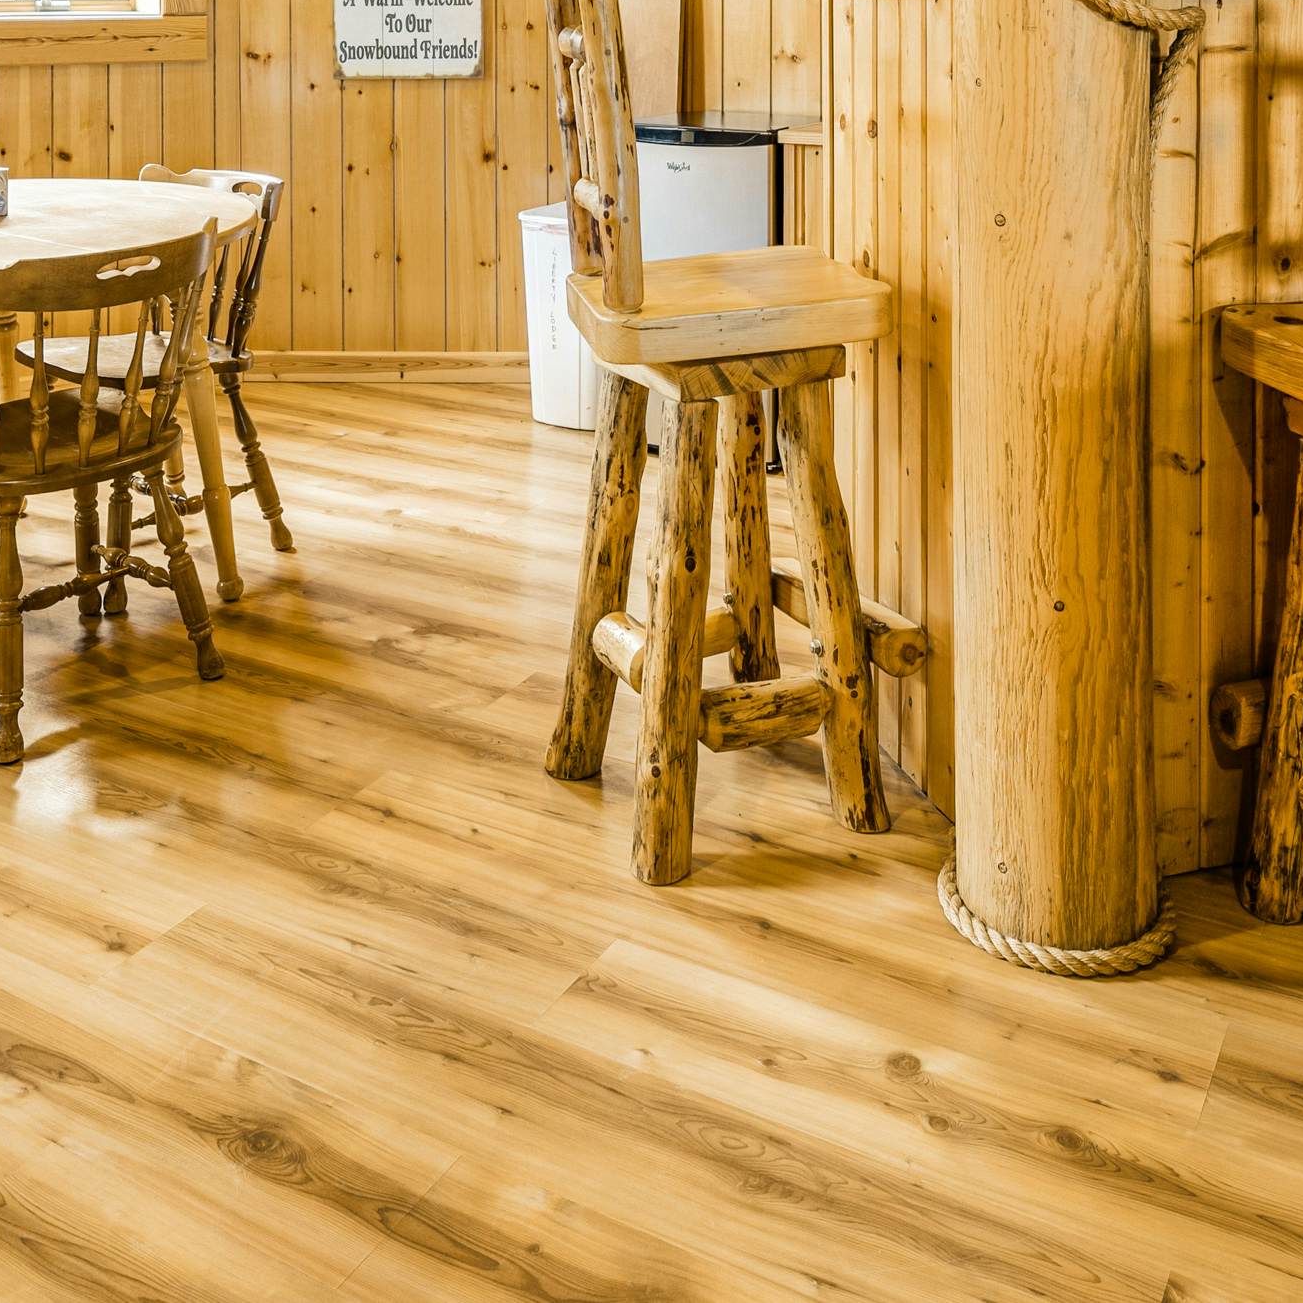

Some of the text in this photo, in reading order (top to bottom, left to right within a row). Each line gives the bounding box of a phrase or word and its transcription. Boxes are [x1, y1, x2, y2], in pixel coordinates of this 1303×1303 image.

[385, 13, 432, 33] To Our
[339, 37, 478, 63] Snowbound Friends!
